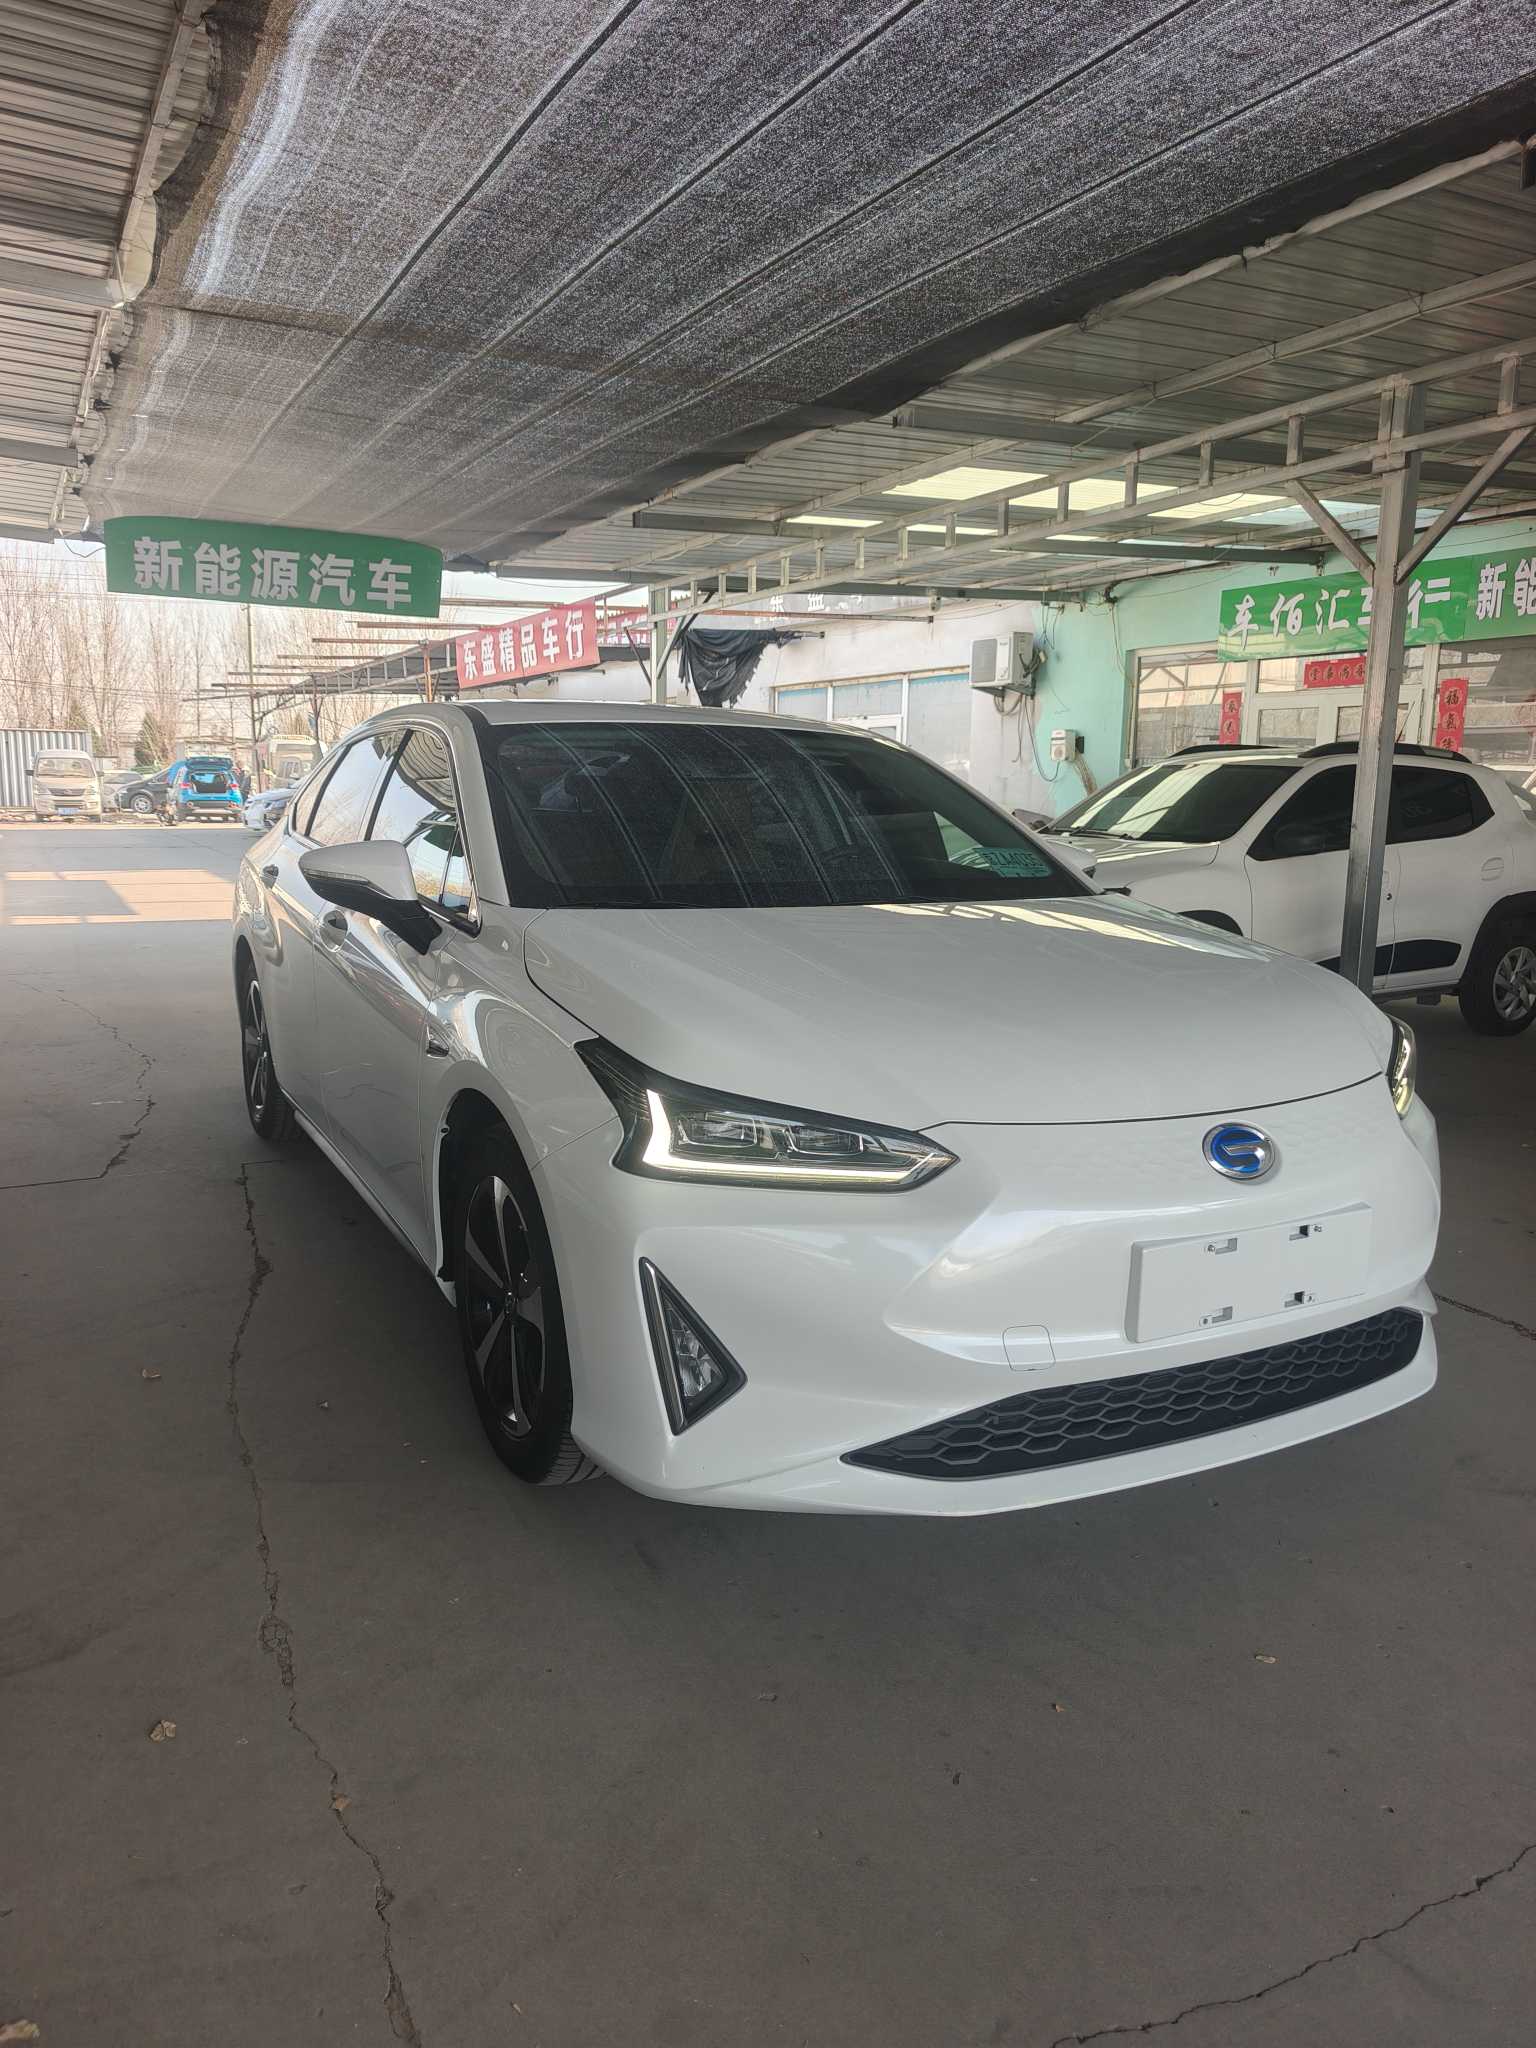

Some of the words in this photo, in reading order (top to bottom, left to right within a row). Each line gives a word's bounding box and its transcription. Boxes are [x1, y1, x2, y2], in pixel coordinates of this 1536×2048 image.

[133, 536, 412, 610] 新能源汽车
[463, 608, 584, 681] 东盛精品车行
